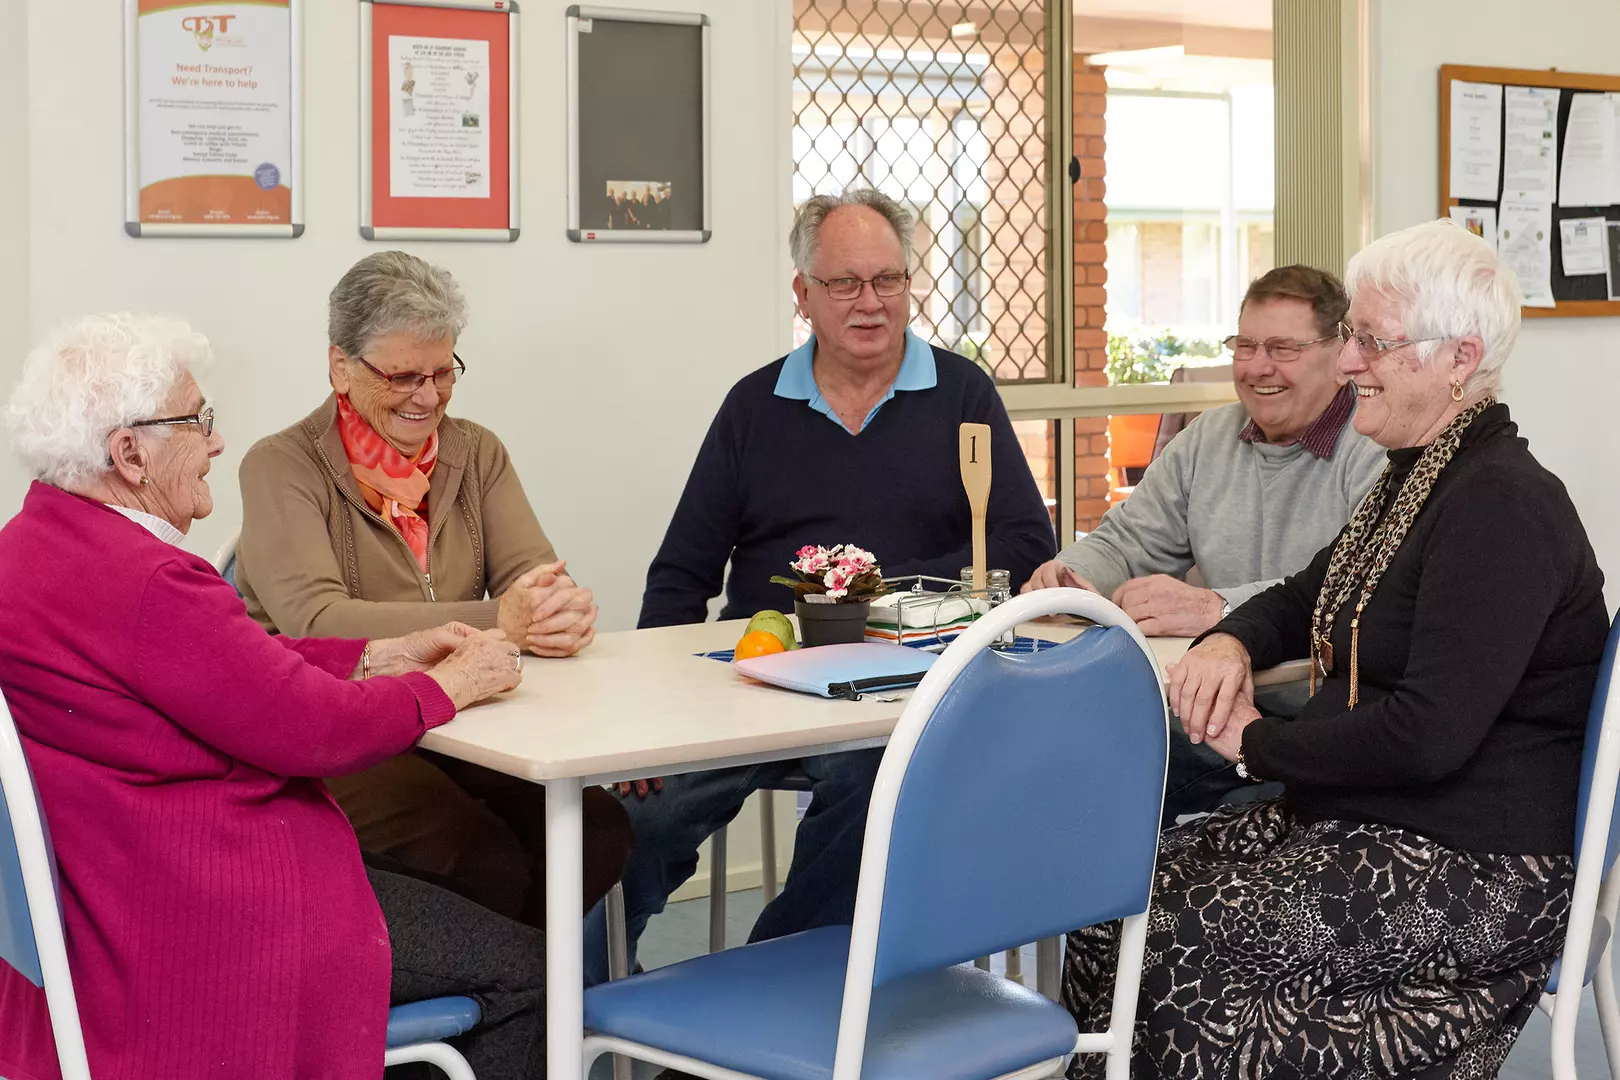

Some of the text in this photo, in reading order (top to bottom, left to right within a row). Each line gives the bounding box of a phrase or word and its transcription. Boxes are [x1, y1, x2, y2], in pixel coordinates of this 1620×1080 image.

[176, 63, 253, 75] Need Transport?
[172, 76, 258, 90] We're here to help
[969, 435, 977, 464] 1
